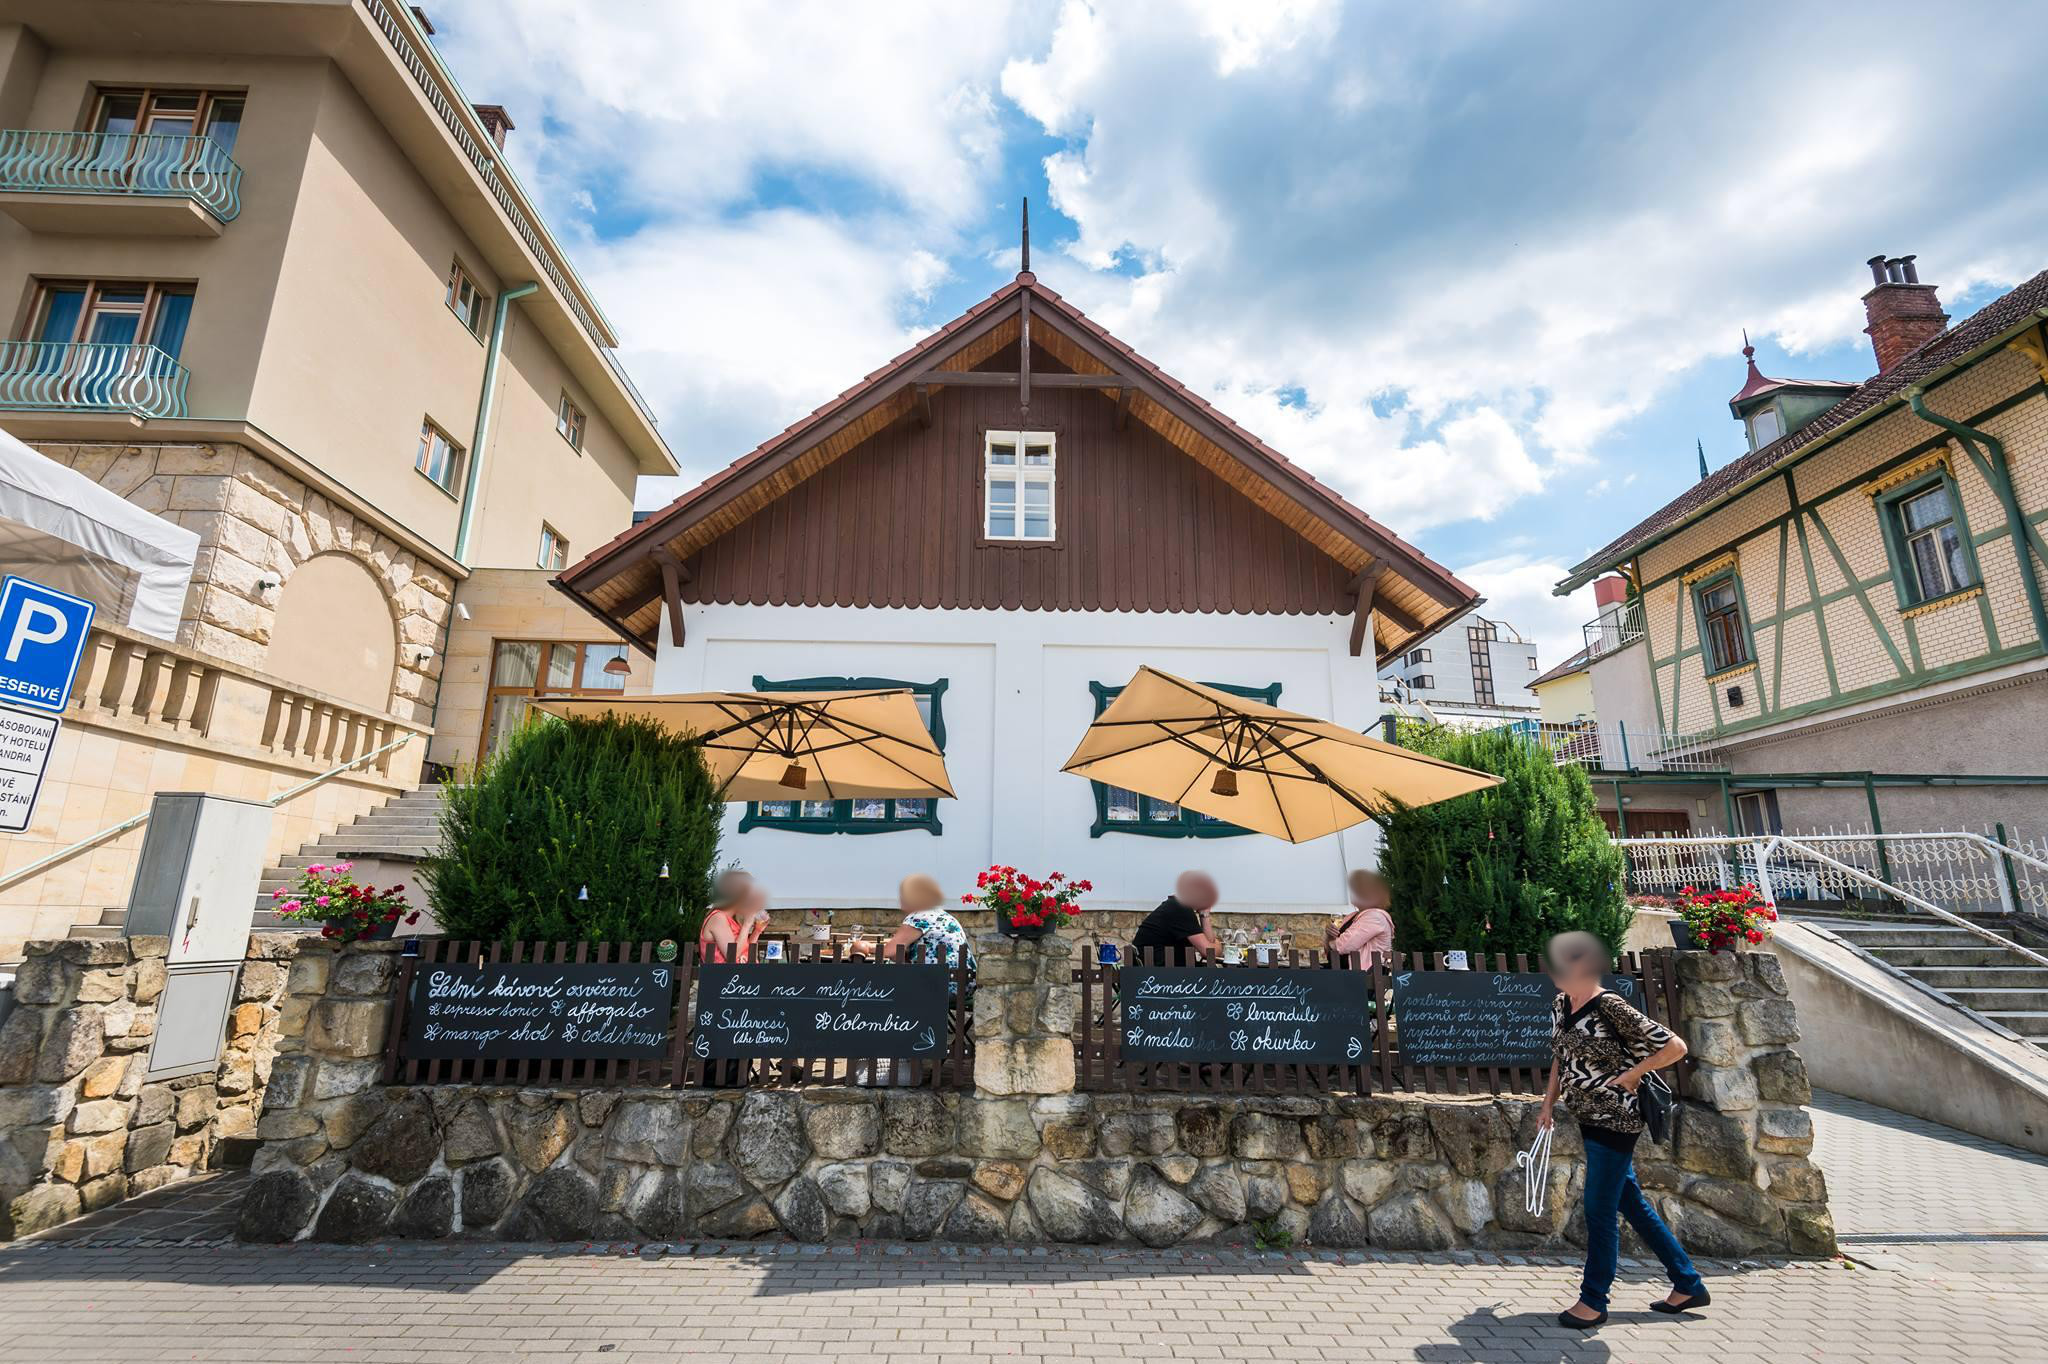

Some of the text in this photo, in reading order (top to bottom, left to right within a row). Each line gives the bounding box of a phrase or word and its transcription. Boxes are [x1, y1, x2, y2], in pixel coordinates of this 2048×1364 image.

[4, 597, 69, 663] P
[0, 675, 60, 701] ESERVÉ
[0, 717, 53, 738] ÁSOBOVANÍ
[0, 748, 32, 763] ANDRIA
[9, 736, 47, 752] HOTELU
[428, 970, 486, 999] Letní
[487, 974, 564, 998] kávové
[770, 985, 806, 996] na
[816, 977, 896, 1008] mlýnku
[1208, 977, 1313, 1006] limonády
[442, 1001, 655, 1026] espresso tonic affogato
[717, 1008, 919, 1032] Sulawesi Colombia
[1457, 1008, 1476, 1022] od
[439, 1020, 667, 1051] mango shot cold brew
[1143, 1025, 1317, 1051] máta okurka
